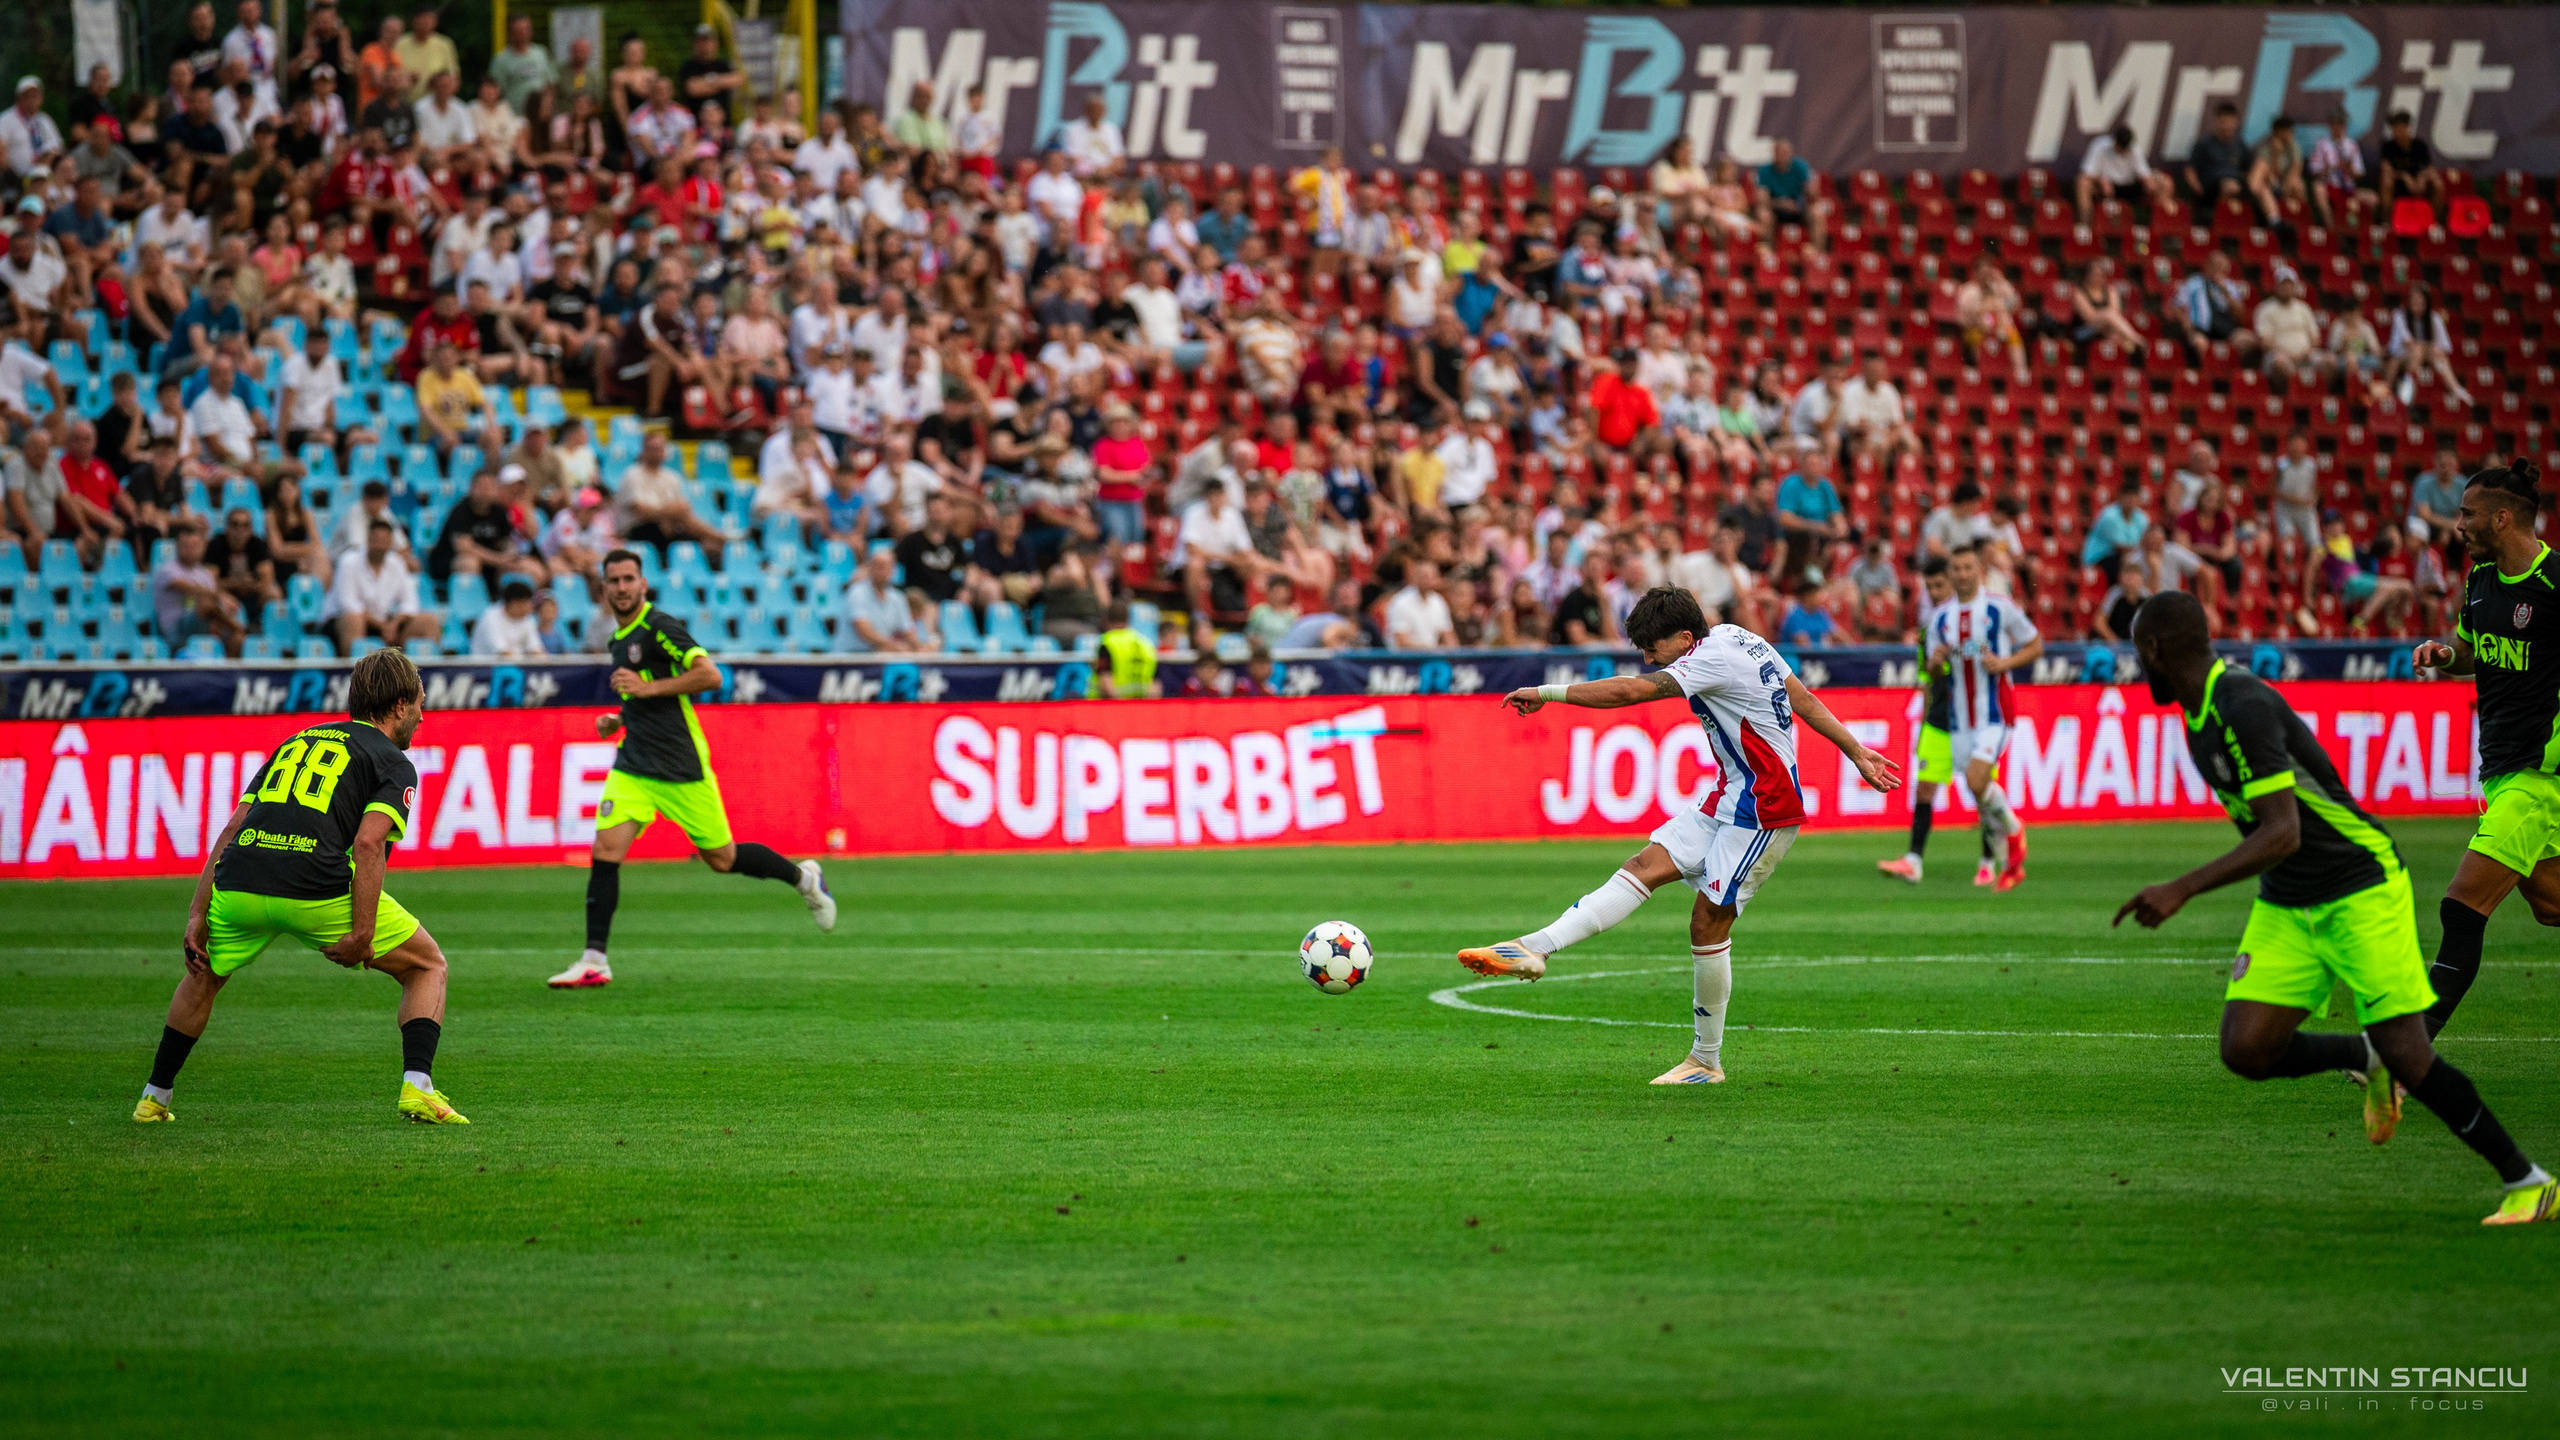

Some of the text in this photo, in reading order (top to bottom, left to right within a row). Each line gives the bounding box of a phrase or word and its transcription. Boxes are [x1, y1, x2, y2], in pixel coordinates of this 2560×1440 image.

[884, 2, 1217, 160] MrBit
[1397, 15, 1798, 166] MrBit
[2026, 13, 2514, 163] MrBit
[19, 670, 167, 719] MrBit
[257, 830, 287, 843] Roata
[258, 739, 351, 815] 88
[396, 742, 617, 851] TALE
[930, 706, 1386, 846] SUPERBET
